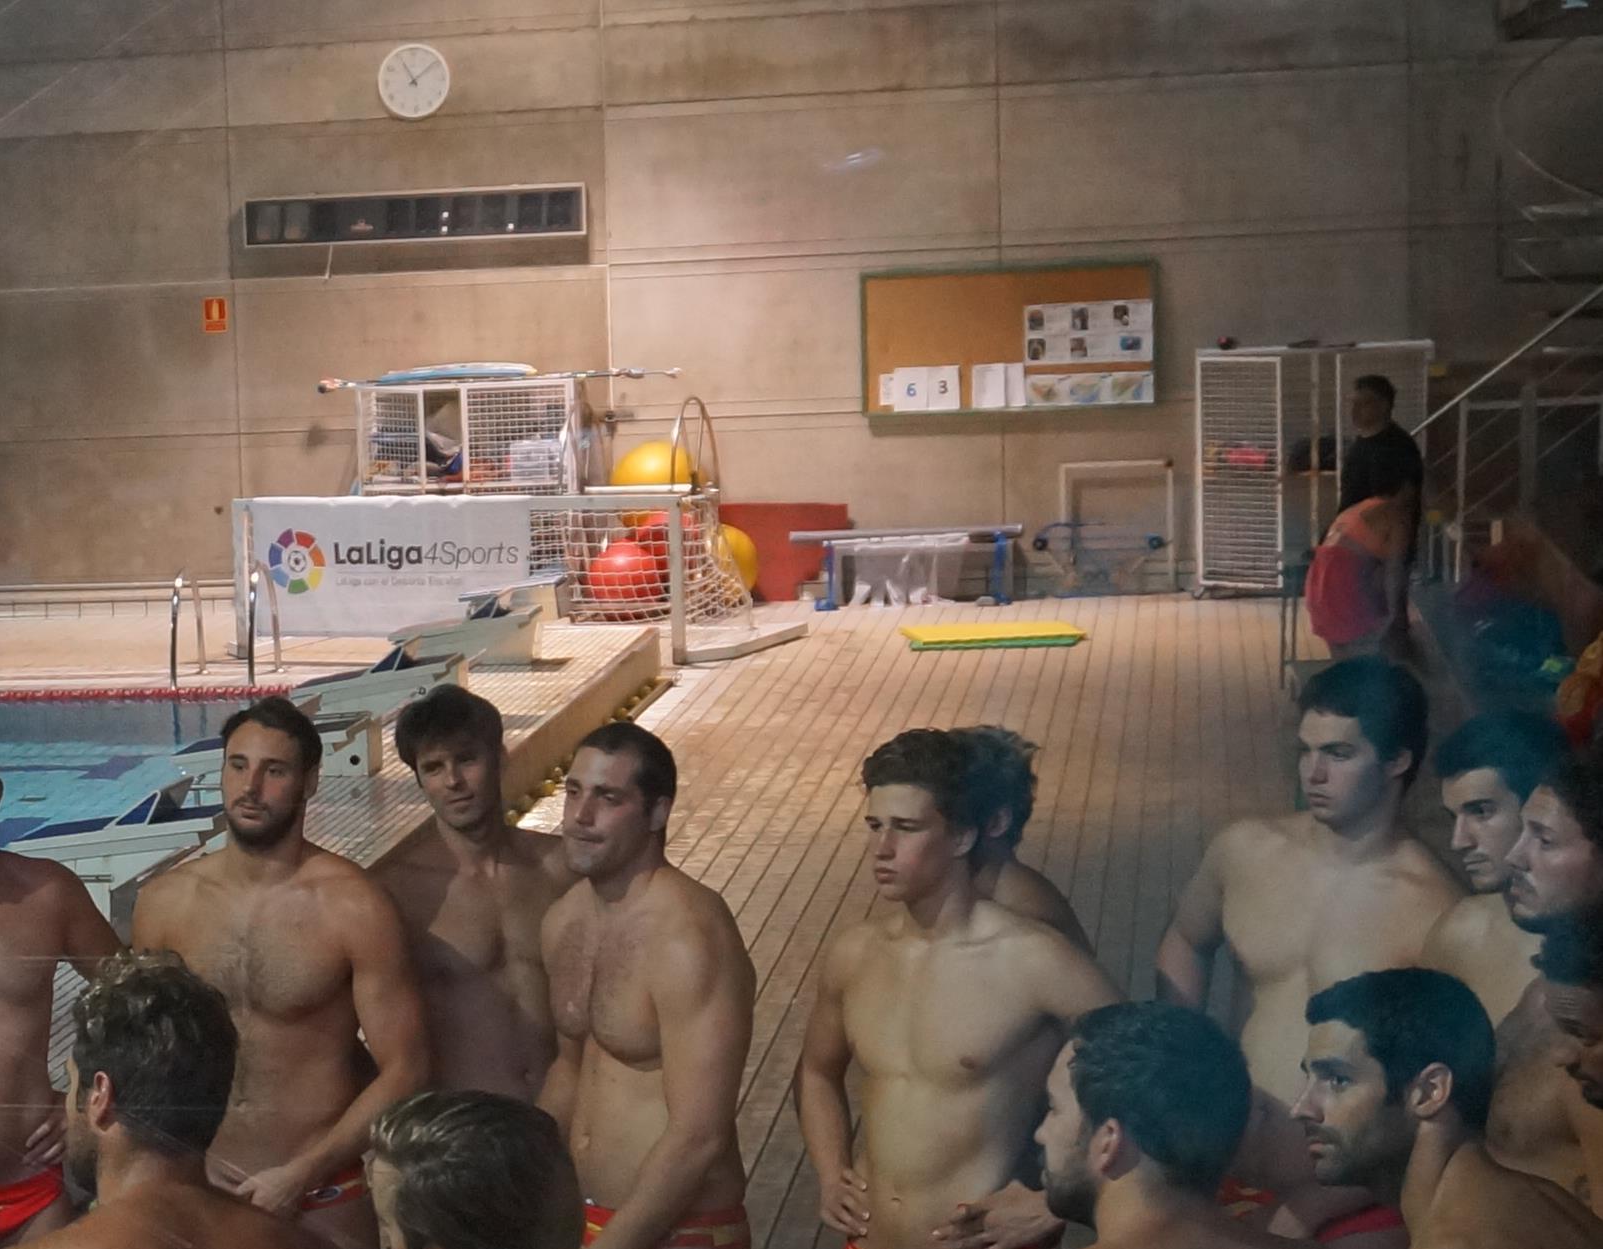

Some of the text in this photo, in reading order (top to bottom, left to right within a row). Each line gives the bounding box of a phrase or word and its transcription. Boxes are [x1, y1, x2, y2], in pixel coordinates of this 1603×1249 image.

[906, 382, 917, 397] 6
[939, 379, 949, 395] 3
[333, 538, 519, 570] LaLiga4Sports
